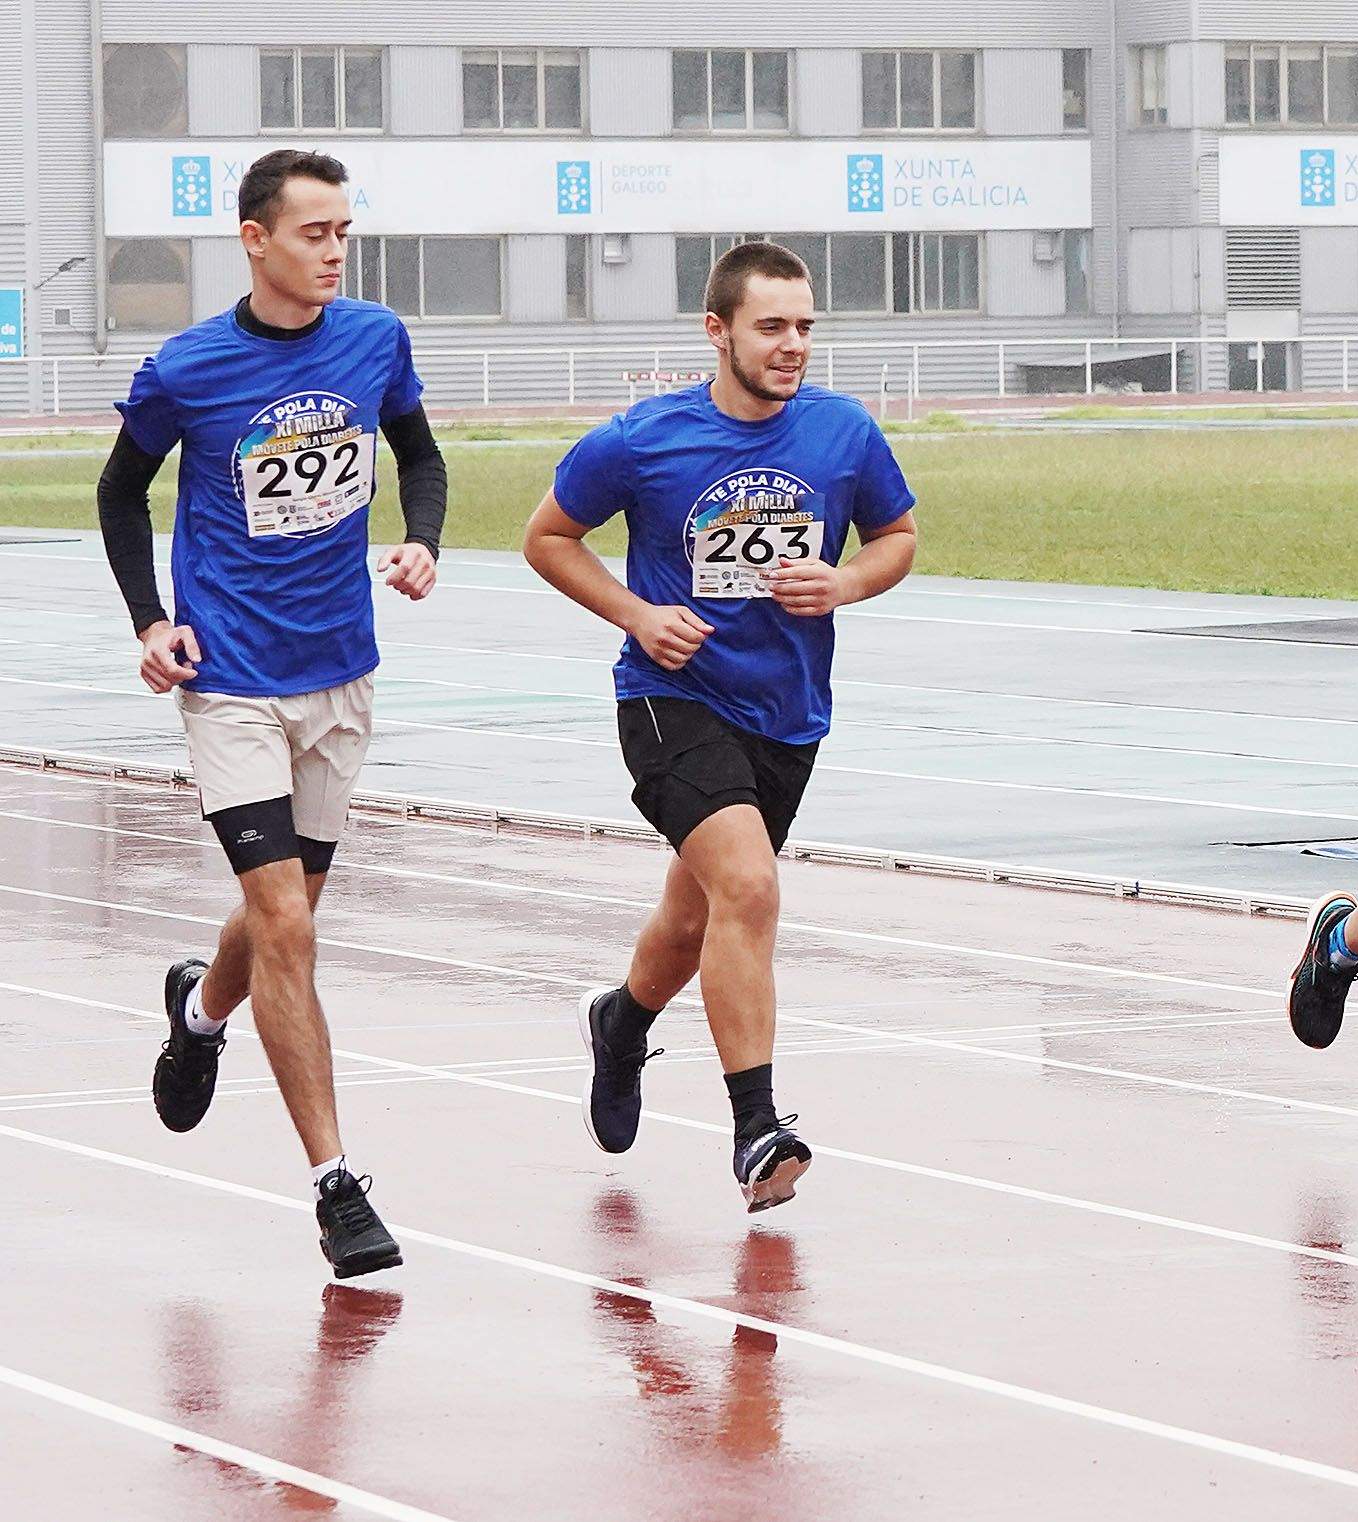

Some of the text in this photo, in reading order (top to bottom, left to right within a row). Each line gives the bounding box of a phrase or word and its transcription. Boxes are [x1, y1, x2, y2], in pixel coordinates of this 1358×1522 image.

[612, 165, 672, 177] DEPORTE
[895, 159, 977, 179] XUNTA
[612, 181, 666, 194] GALEGO
[893, 186, 1029, 207] DE GALICIA
[274, 398, 317, 420] POLA
[275, 420, 292, 438] XI
[295, 411, 345, 435] MILLA
[257, 442, 359, 498] 292
[727, 474, 768, 492] POLA
[731, 494, 795, 512] XI MILLA
[746, 512, 769, 524] POLA
[770, 511, 814, 524] DIABETES
[705, 525, 810, 564] 263
